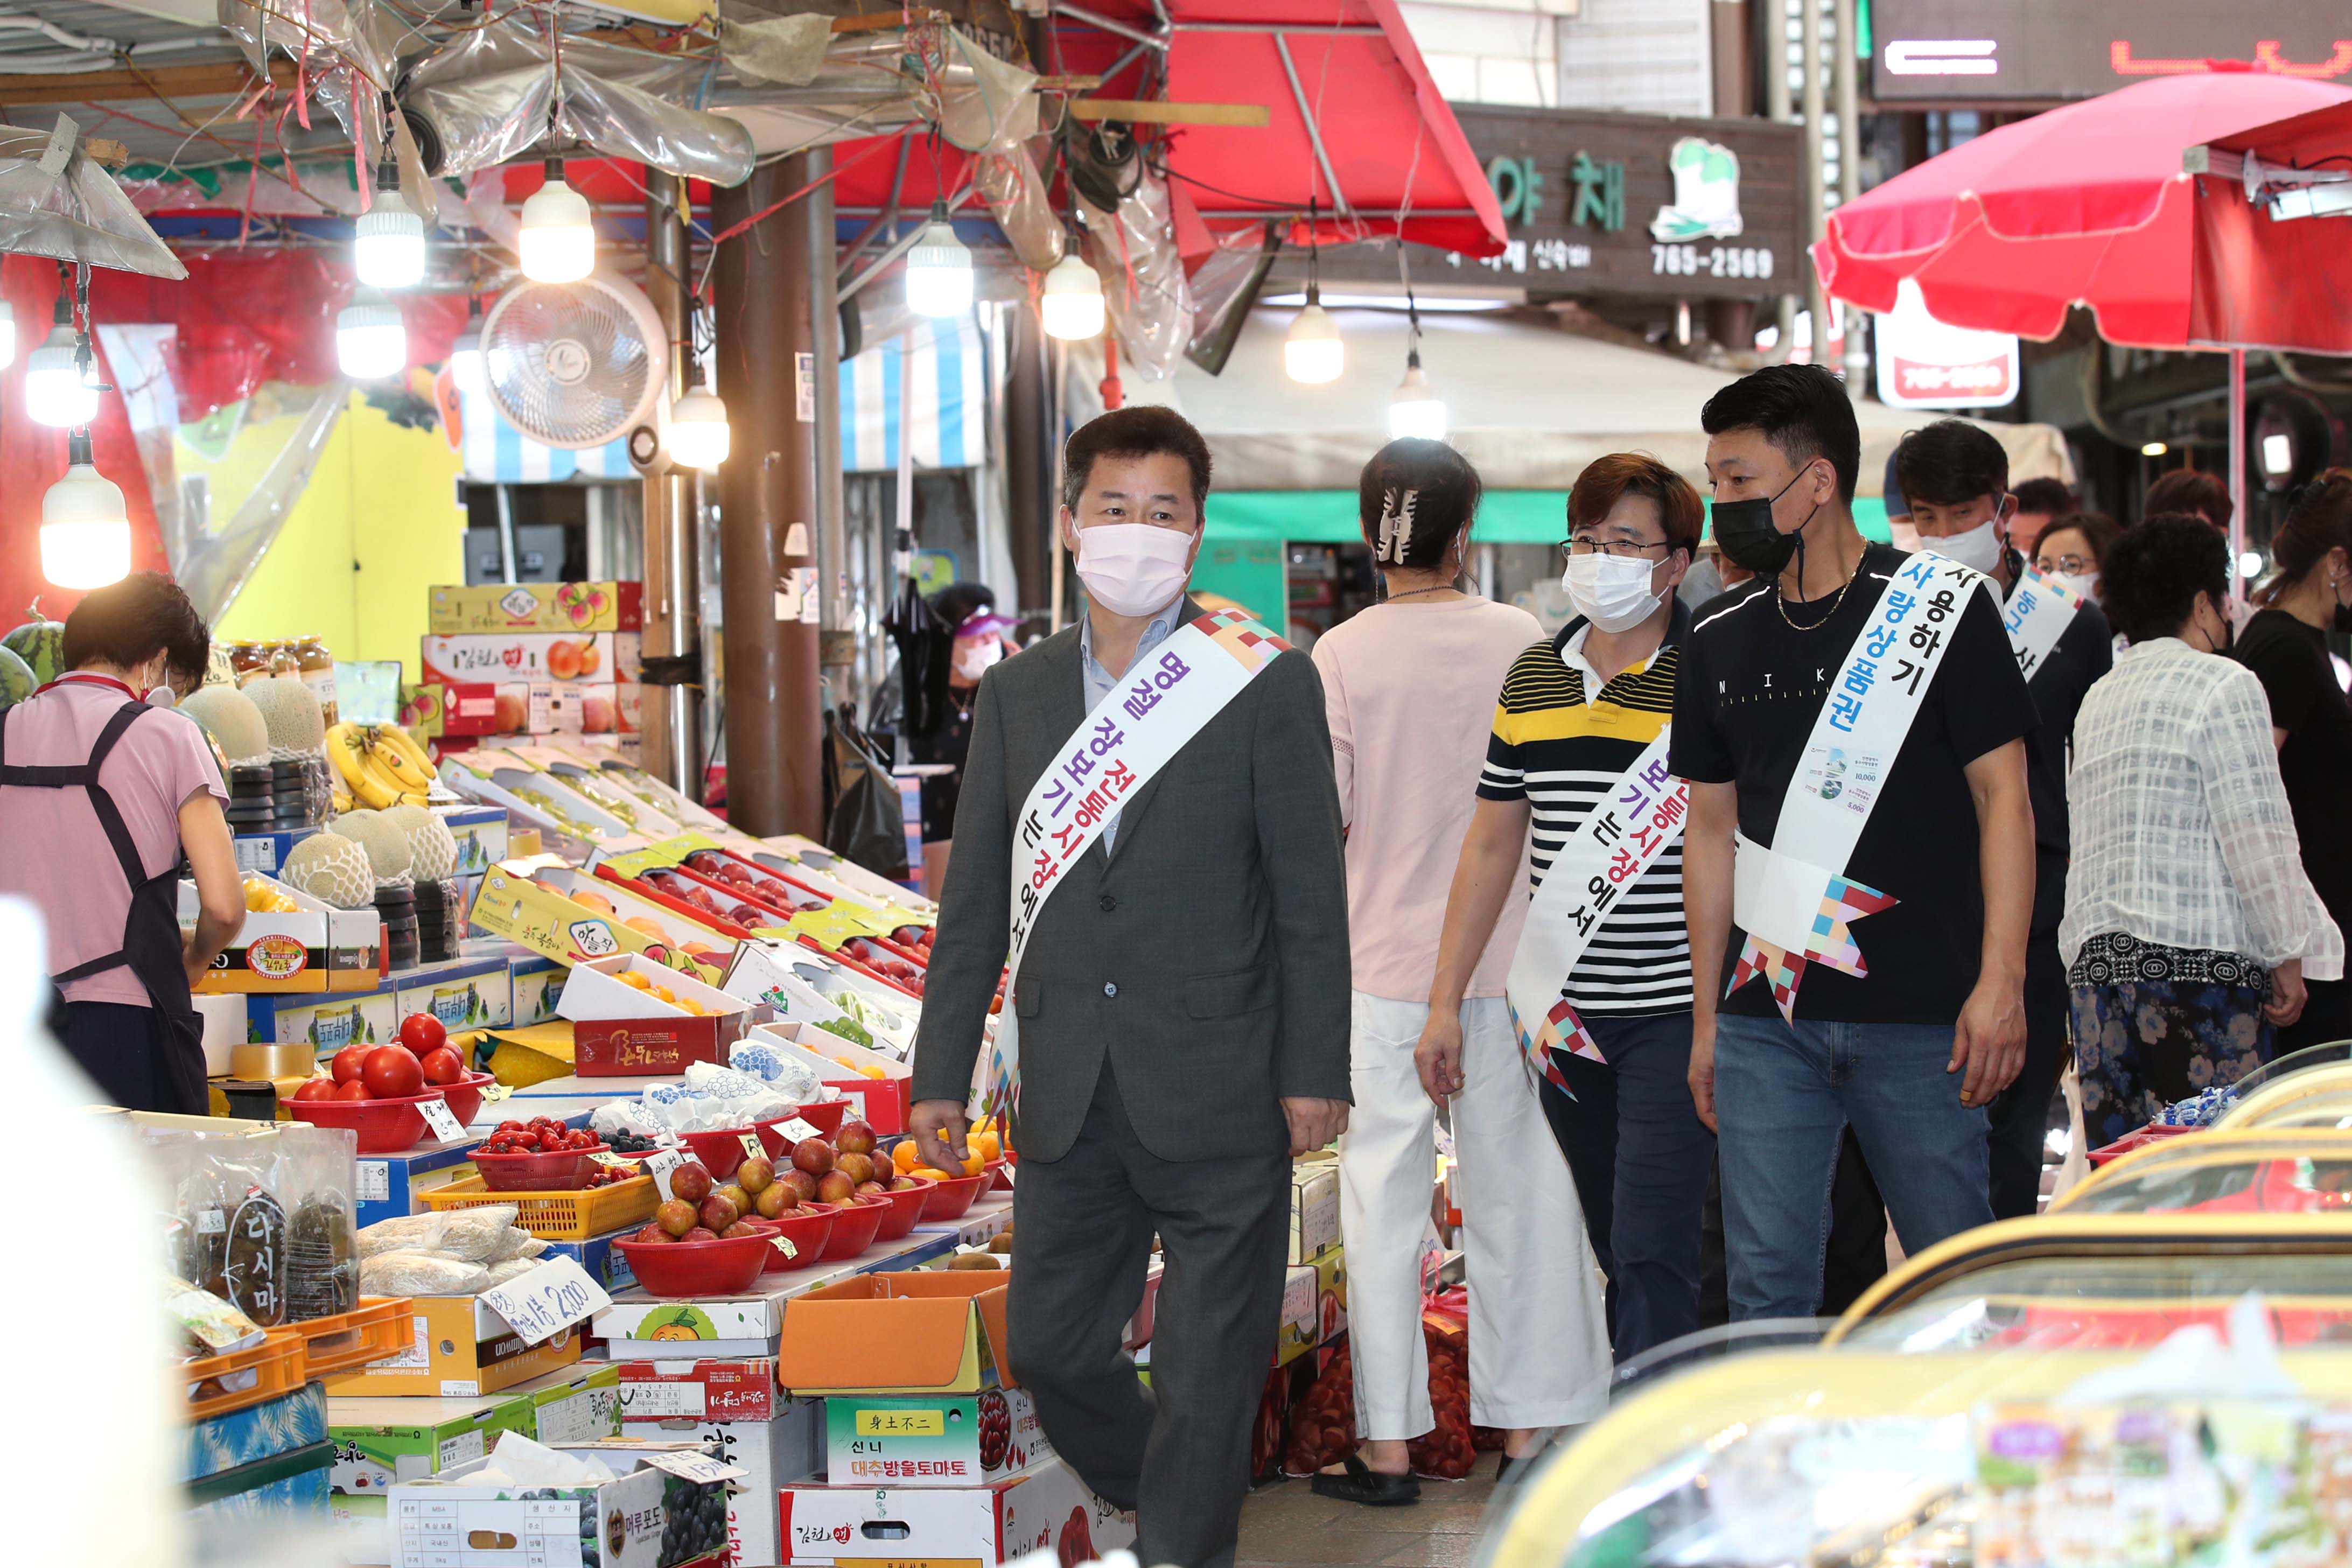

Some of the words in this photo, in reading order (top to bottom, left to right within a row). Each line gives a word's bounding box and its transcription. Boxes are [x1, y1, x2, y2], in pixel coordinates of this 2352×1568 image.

[1651, 244, 1774, 278] 765-2569
[1891, 567, 1977, 696] 사용하기
[1123, 650, 1191, 721] 명절
[1023, 716, 1125, 849] 장보기는
[1854, 772, 1877, 783] 10,000
[1592, 751, 1670, 847] 보기는
[1847, 802, 1865, 814] 5,000
[1012, 758, 1137, 954] 전통시장에서
[245, 1211, 278, 1315] 다시마
[710, 1390, 740, 1408] 딸기
[870, 1415, 930, 1430] 身土不二
[851, 1459, 968, 1477] 대추방울토마토
[625, 1506, 662, 1536] 머루포도
